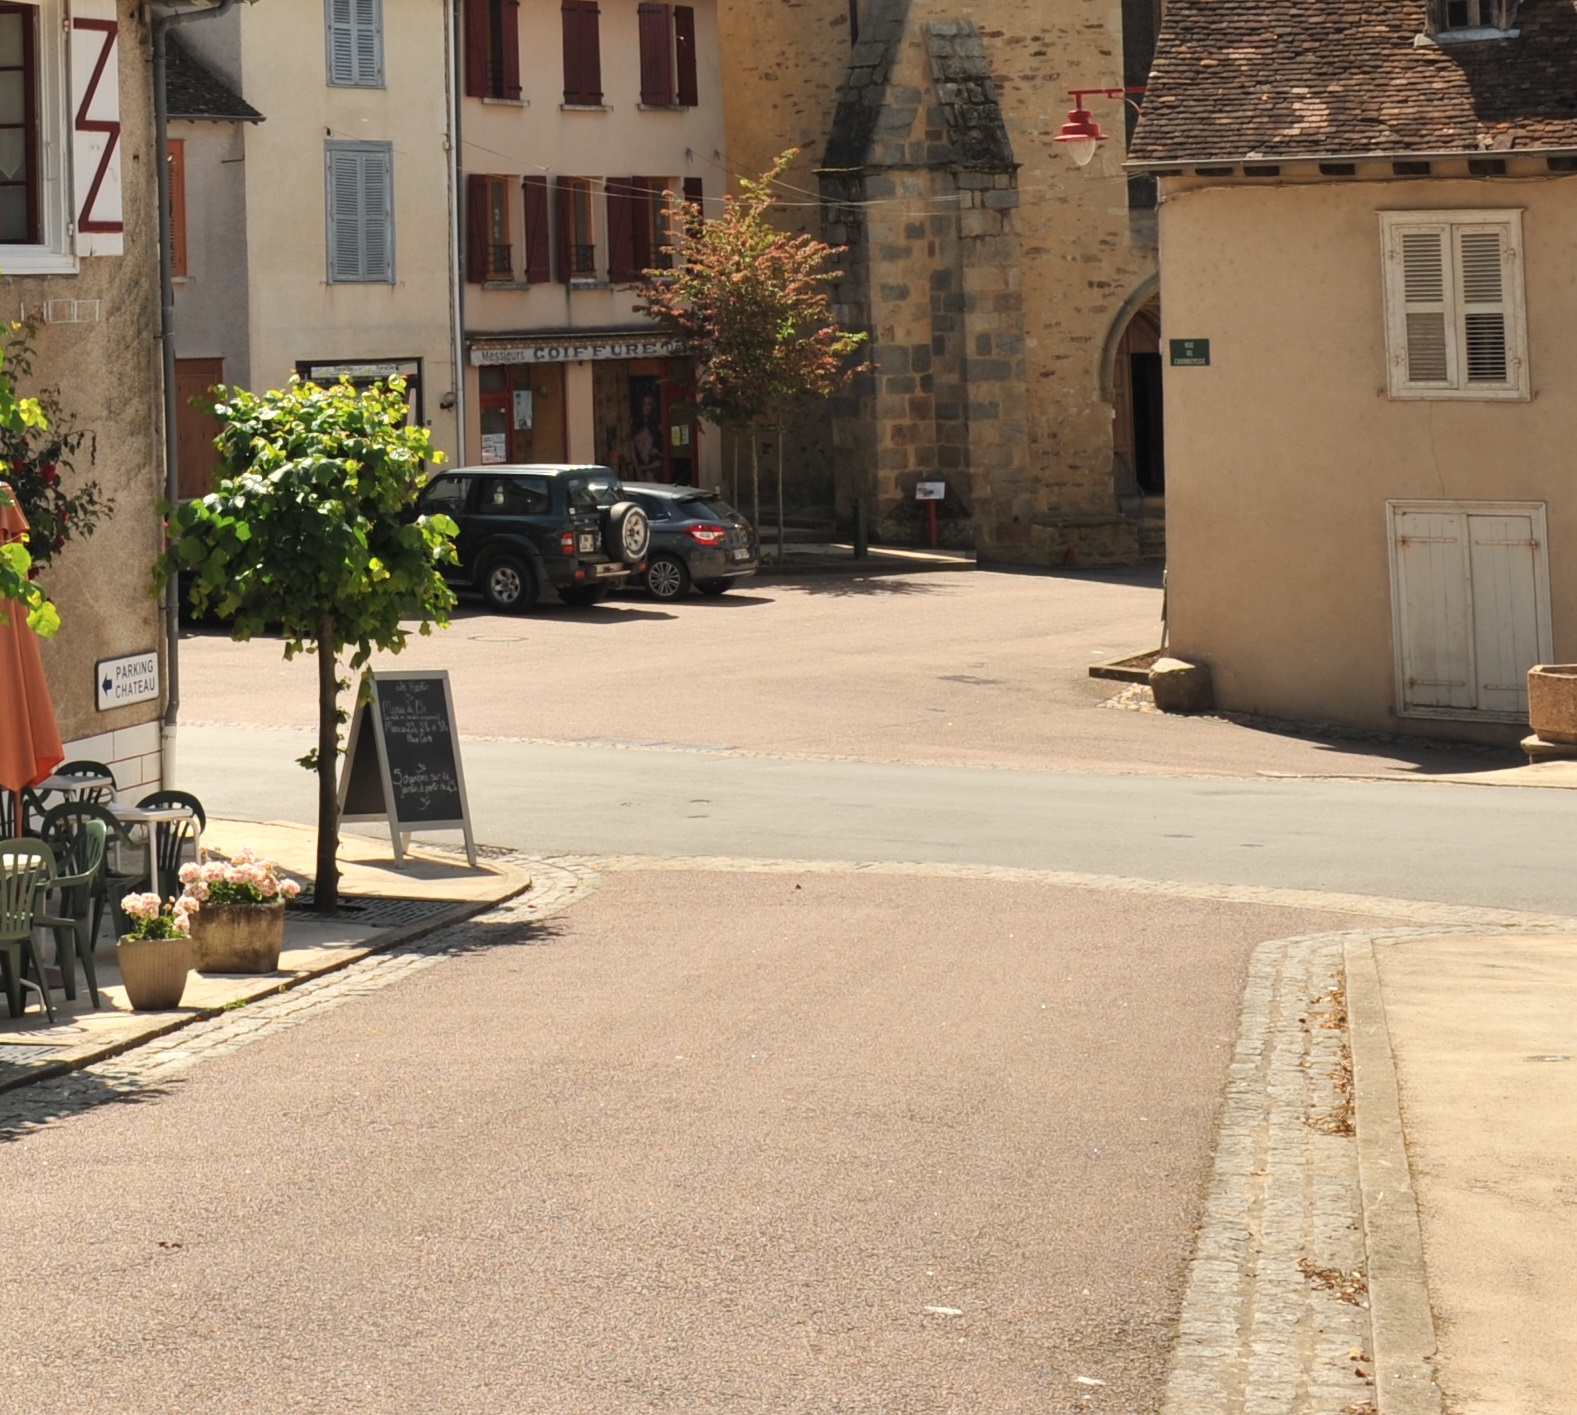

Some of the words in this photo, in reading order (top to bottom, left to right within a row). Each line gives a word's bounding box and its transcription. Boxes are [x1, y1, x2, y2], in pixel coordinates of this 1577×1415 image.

[482, 350, 525, 362] Messieurs
[533, 342, 657, 360] COIFFURE
[115, 659, 154, 681] PARKING
[115, 677, 156, 699] CHATEAU
